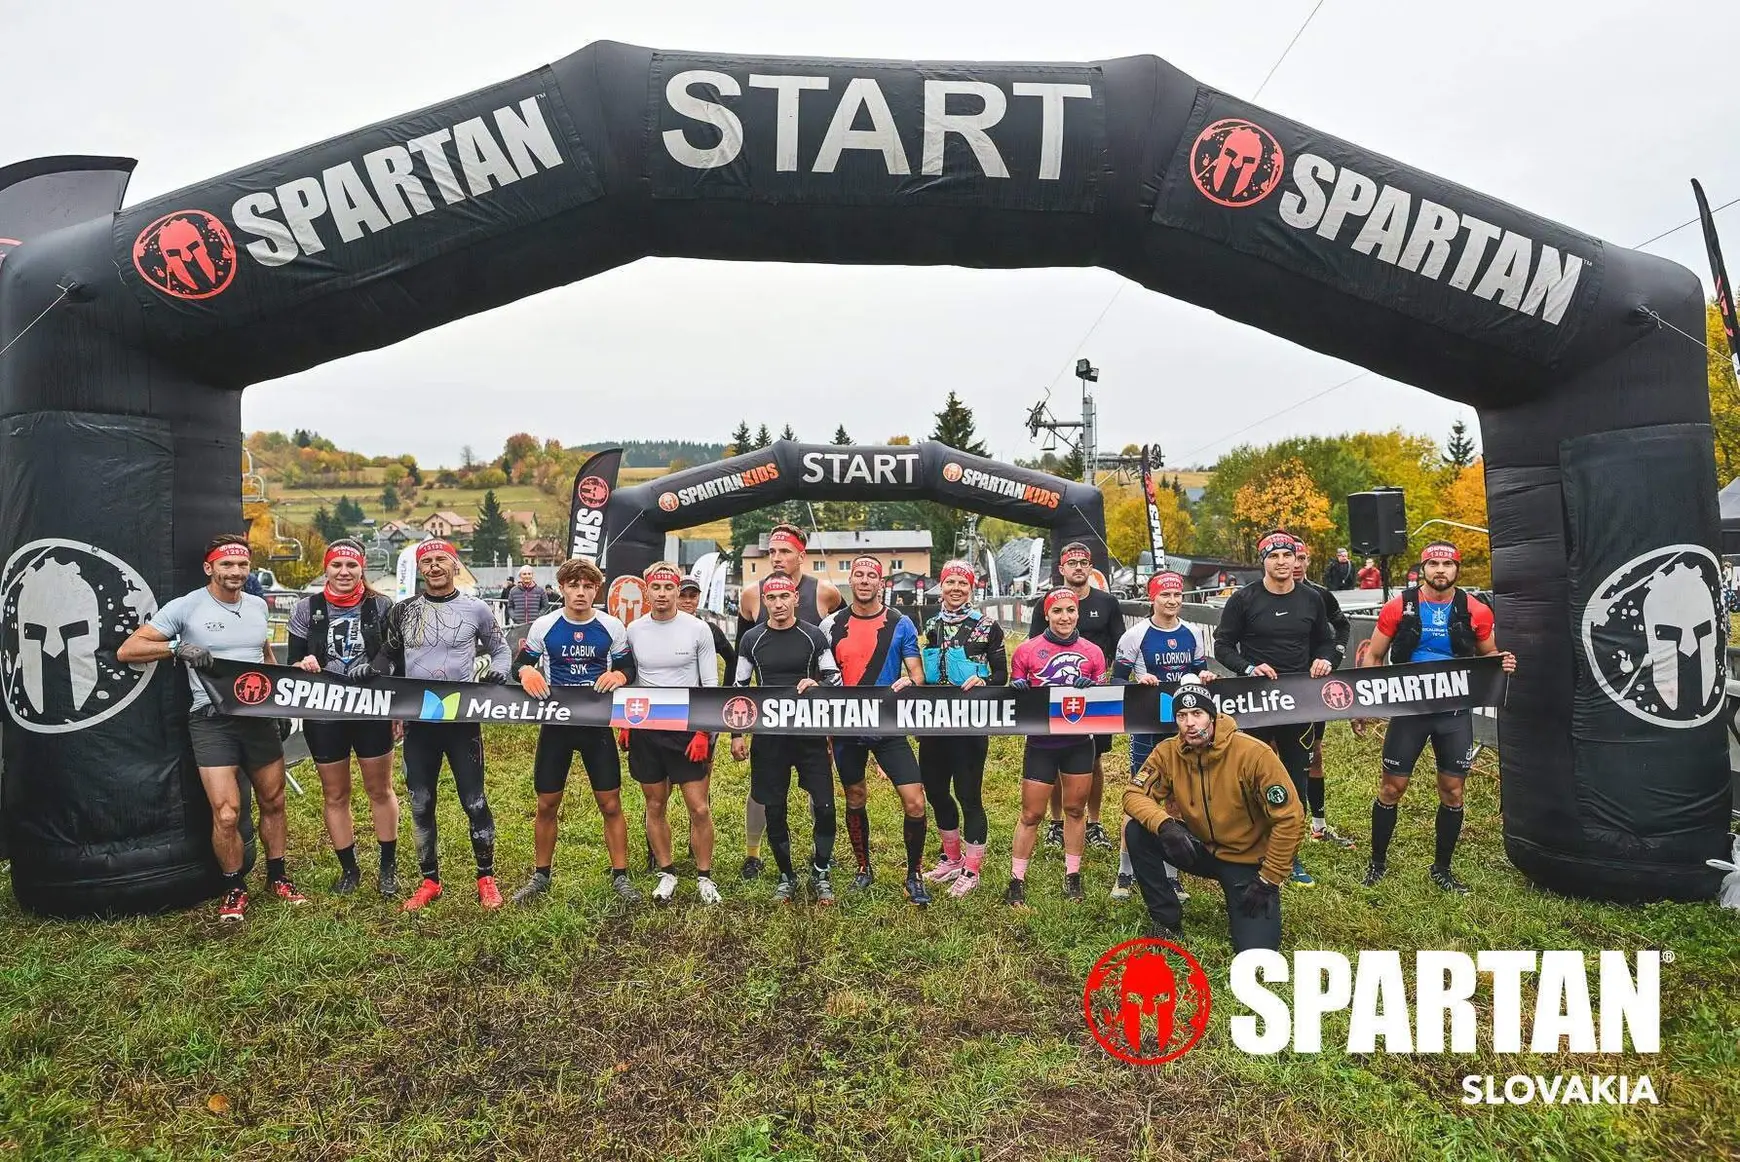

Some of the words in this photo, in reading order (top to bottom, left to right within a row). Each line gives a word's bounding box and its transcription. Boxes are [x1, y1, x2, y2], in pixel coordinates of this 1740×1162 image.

[663, 70, 1092, 179] START
[803, 453, 919, 483] START
[573, 508, 603, 564] SPA
[570, 645, 596, 657] CABUK
[570, 663, 588, 675] SVK
[1166, 671, 1183, 682] SVK
[275, 678, 391, 716] SPARTAN
[1356, 670, 1470, 705] SPARTAN
[466, 698, 572, 721] MetLife
[762, 699, 880, 728] SPARTAN
[897, 699, 1016, 728] KRAHULE
